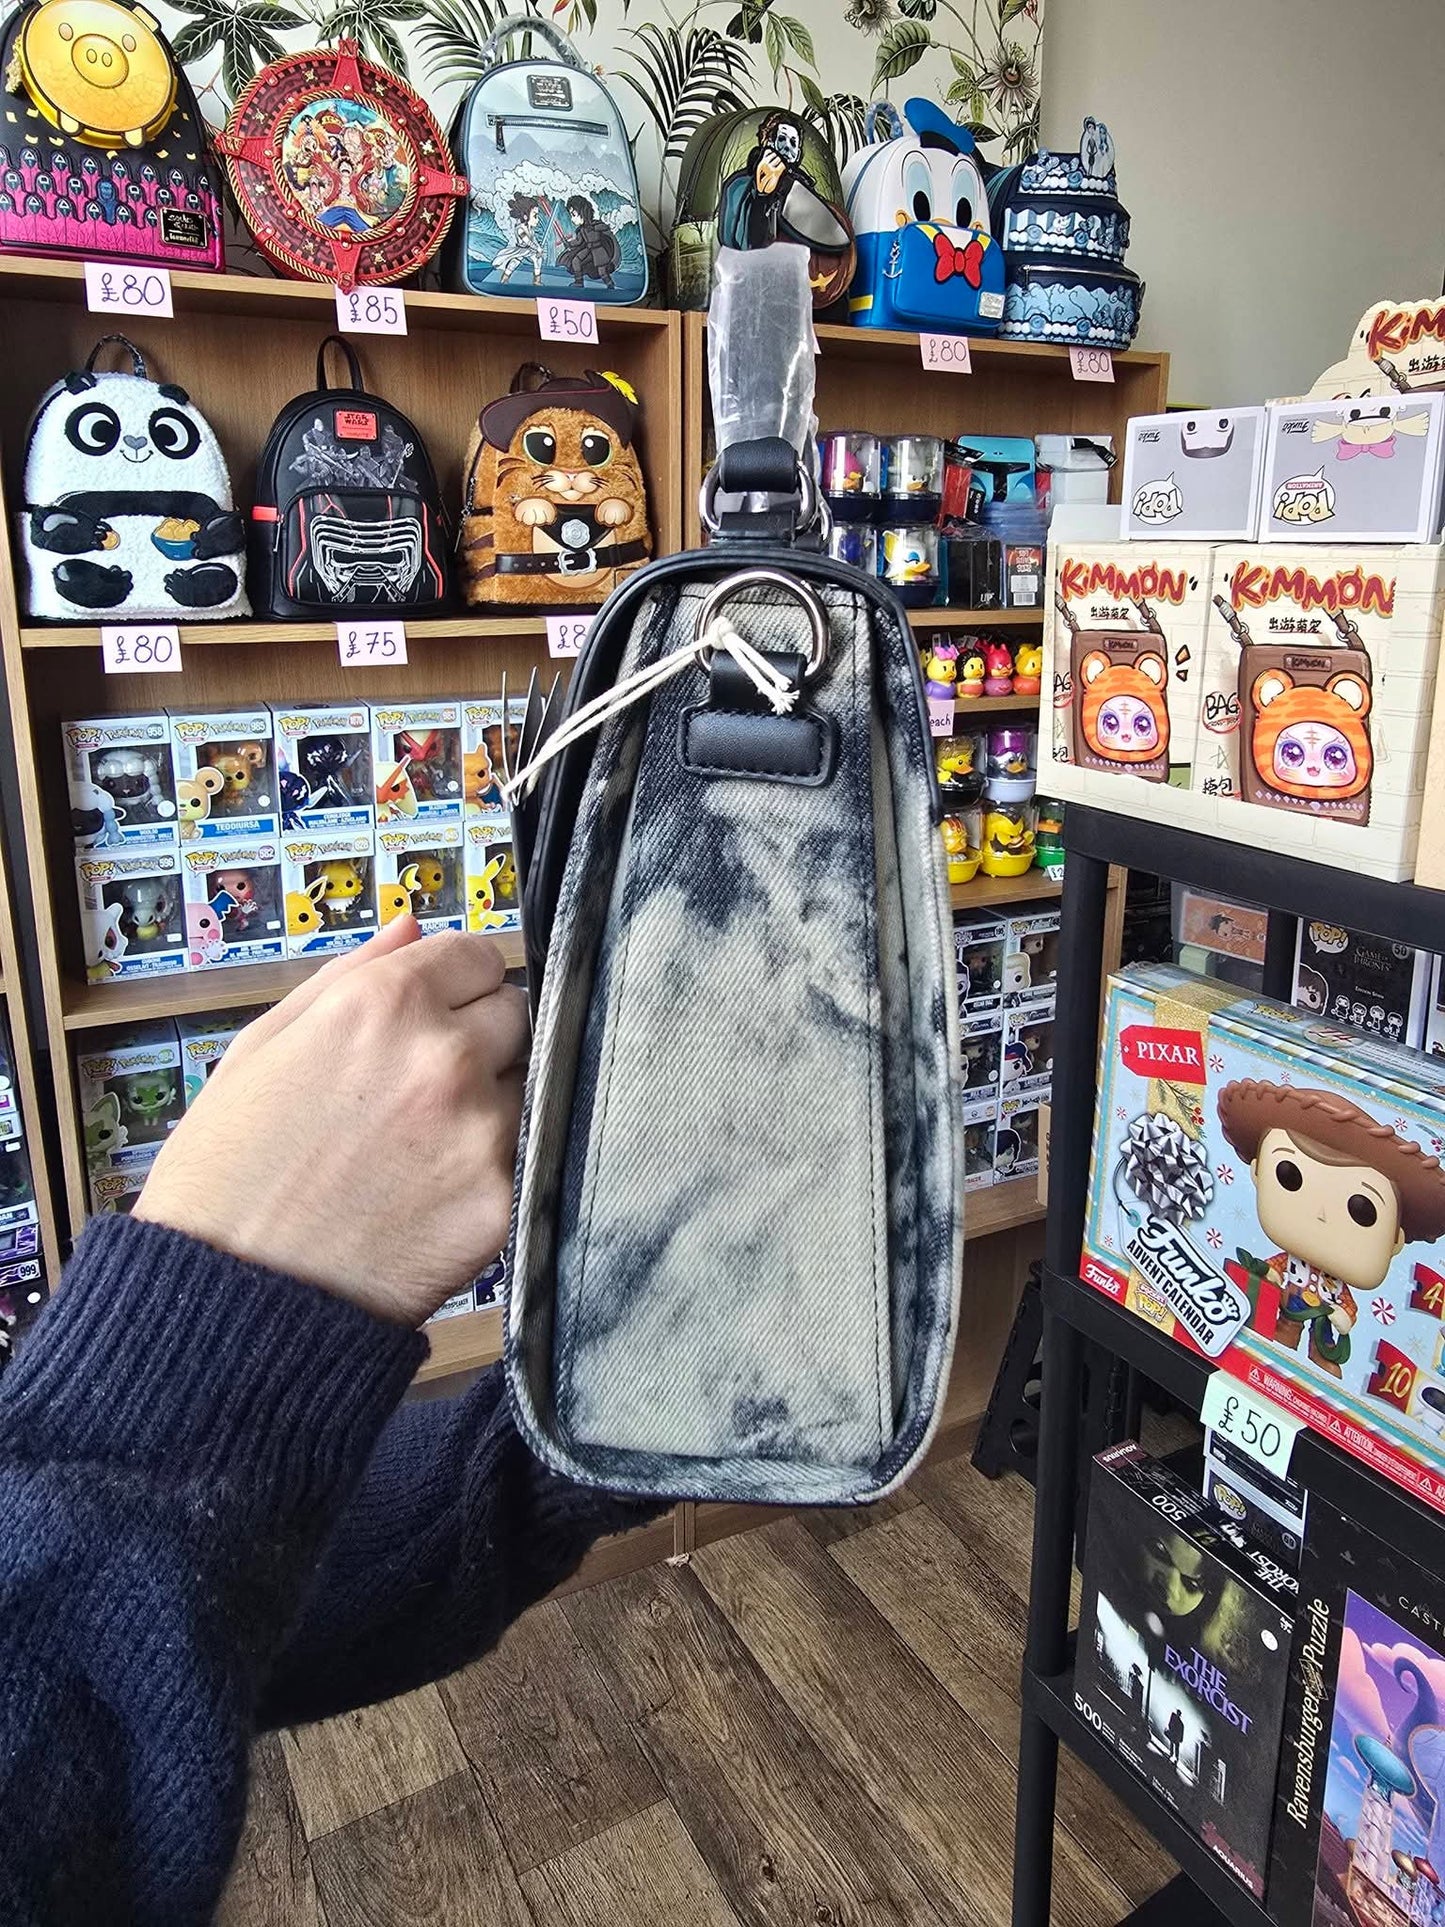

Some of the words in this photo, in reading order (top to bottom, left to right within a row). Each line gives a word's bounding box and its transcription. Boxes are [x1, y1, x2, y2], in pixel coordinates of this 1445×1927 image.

[101, 273, 165, 306] £80
[349, 293, 398, 324] £85
[549, 306, 592, 337] £50
[929, 339, 967, 363] £80
[1077, 350, 1110, 374] £80
[115, 635, 172, 664] £80
[346, 631, 397, 658] £75
[557, 624, 587, 649] £8
[1054, 671, 1073, 692] AG
[1206, 692, 1239, 720] BAG
[216, 821, 260, 830] TEDDIURSA
[1309, 922, 1348, 947] POP!
[1136, 1041, 1201, 1067] PIXAR
[20, 1264, 37, 1277] 999
[1085, 1264, 1121, 1295] Funko
[1137, 1214, 1241, 1325] Funko
[1127, 1239, 1166, 1287] ADVENT
[1161, 1278, 1215, 1345] CALENDAR
[1423, 1281, 1444, 1310] 4
[1379, 1362, 1412, 1398] 10
[1218, 1396, 1281, 1457] £50
[1102, 1444, 1137, 1463] AQUARIUS
[1152, 1495, 1188, 1522] 500
[1254, 1566, 1284, 1593] THE
[1398, 1596, 1445, 1638] CAST
[1302, 1597, 1331, 1671] Puzzle
[1190, 1647, 1228, 1696] THE
[1165, 1643, 1254, 1737] EXORCIST
[1074, 1692, 1102, 1730] 500
[1286, 1680, 1323, 1830] Ravensburger
[1212, 1844, 1254, 1889] AQUARIUS
